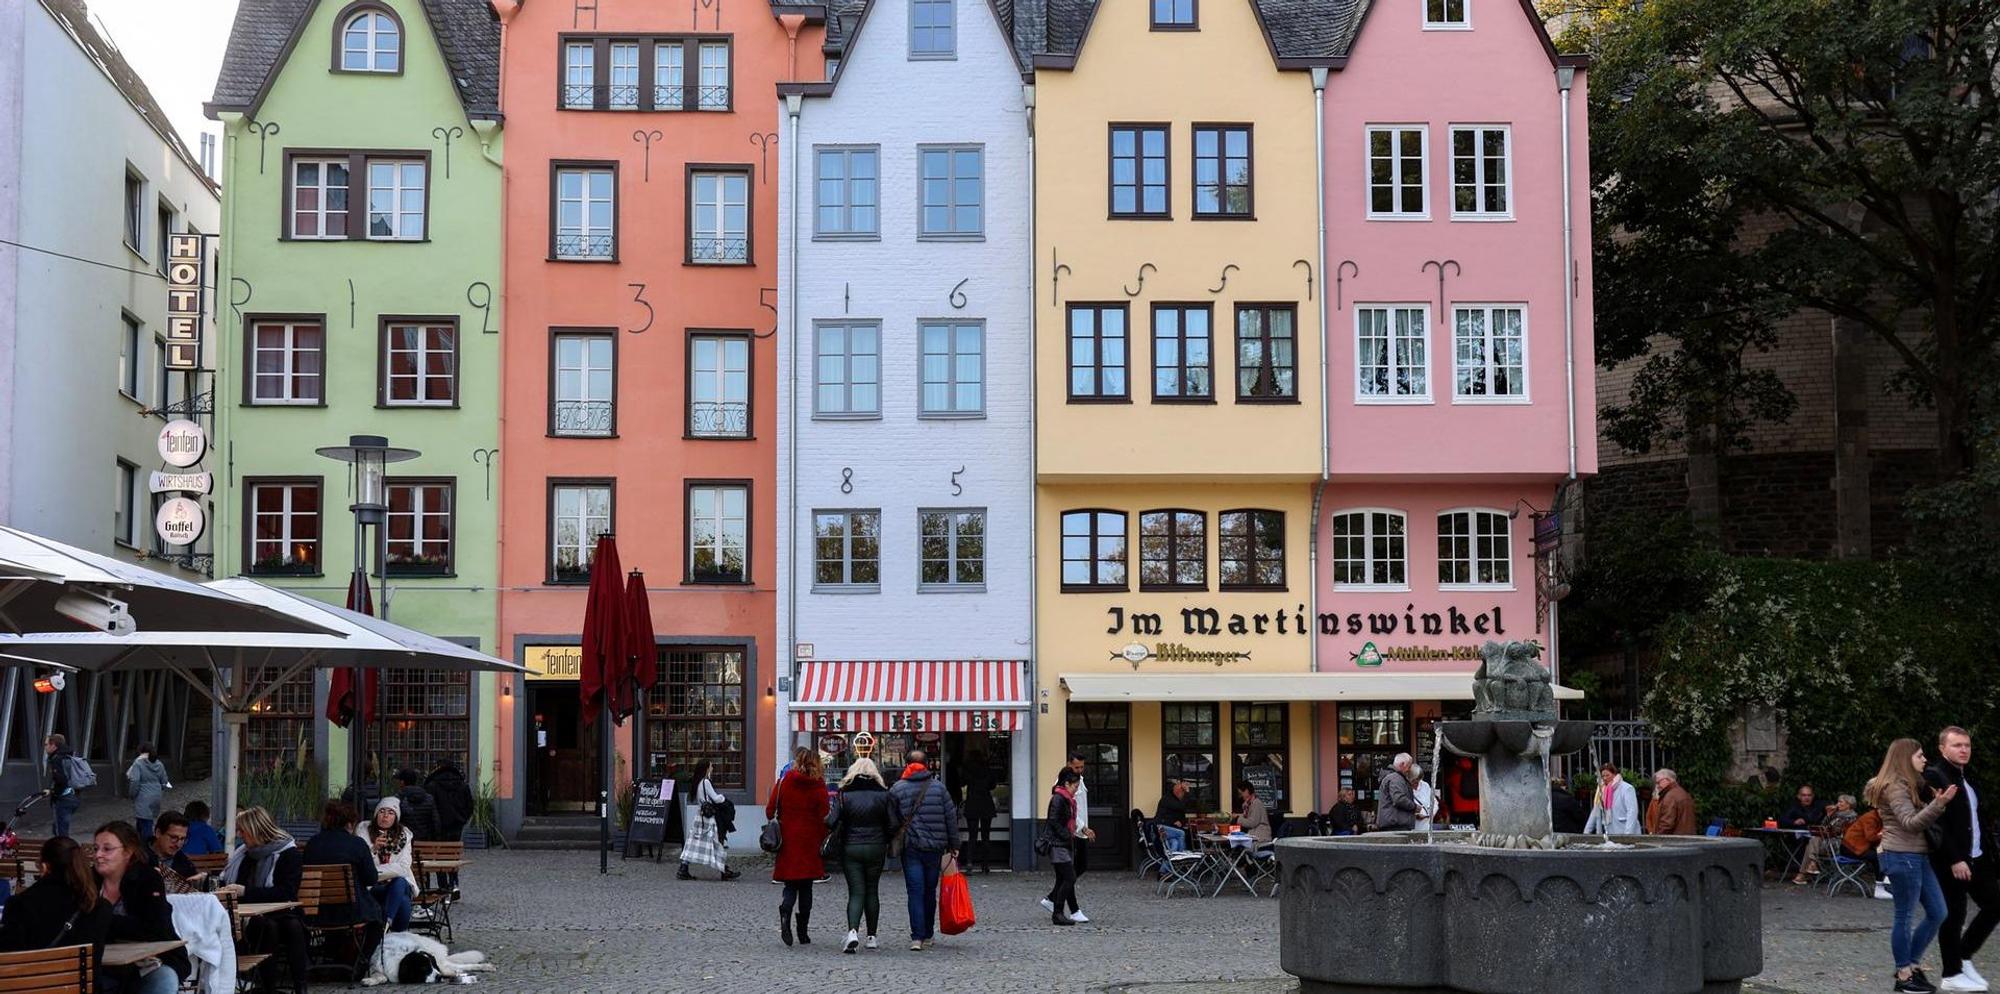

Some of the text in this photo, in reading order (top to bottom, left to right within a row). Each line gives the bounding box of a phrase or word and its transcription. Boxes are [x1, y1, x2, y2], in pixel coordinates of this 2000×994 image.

[171, 237, 197, 365] HOTEL
[949, 278, 969, 309] 6
[628, 283, 654, 334] 3
[158, 475, 204, 489] WIRTSHAUS
[841, 465, 965, 496] 8 5
[165, 520, 194, 532] Gaffel
[1107, 603, 1505, 636] Im Martinswinkel
[1156, 643, 1240, 666] Bitburger
[1387, 646, 1449, 661] Mühlen
[816, 714, 845, 729] Eis
[891, 714, 923, 729] Eis
[971, 714, 1000, 729] Eis
